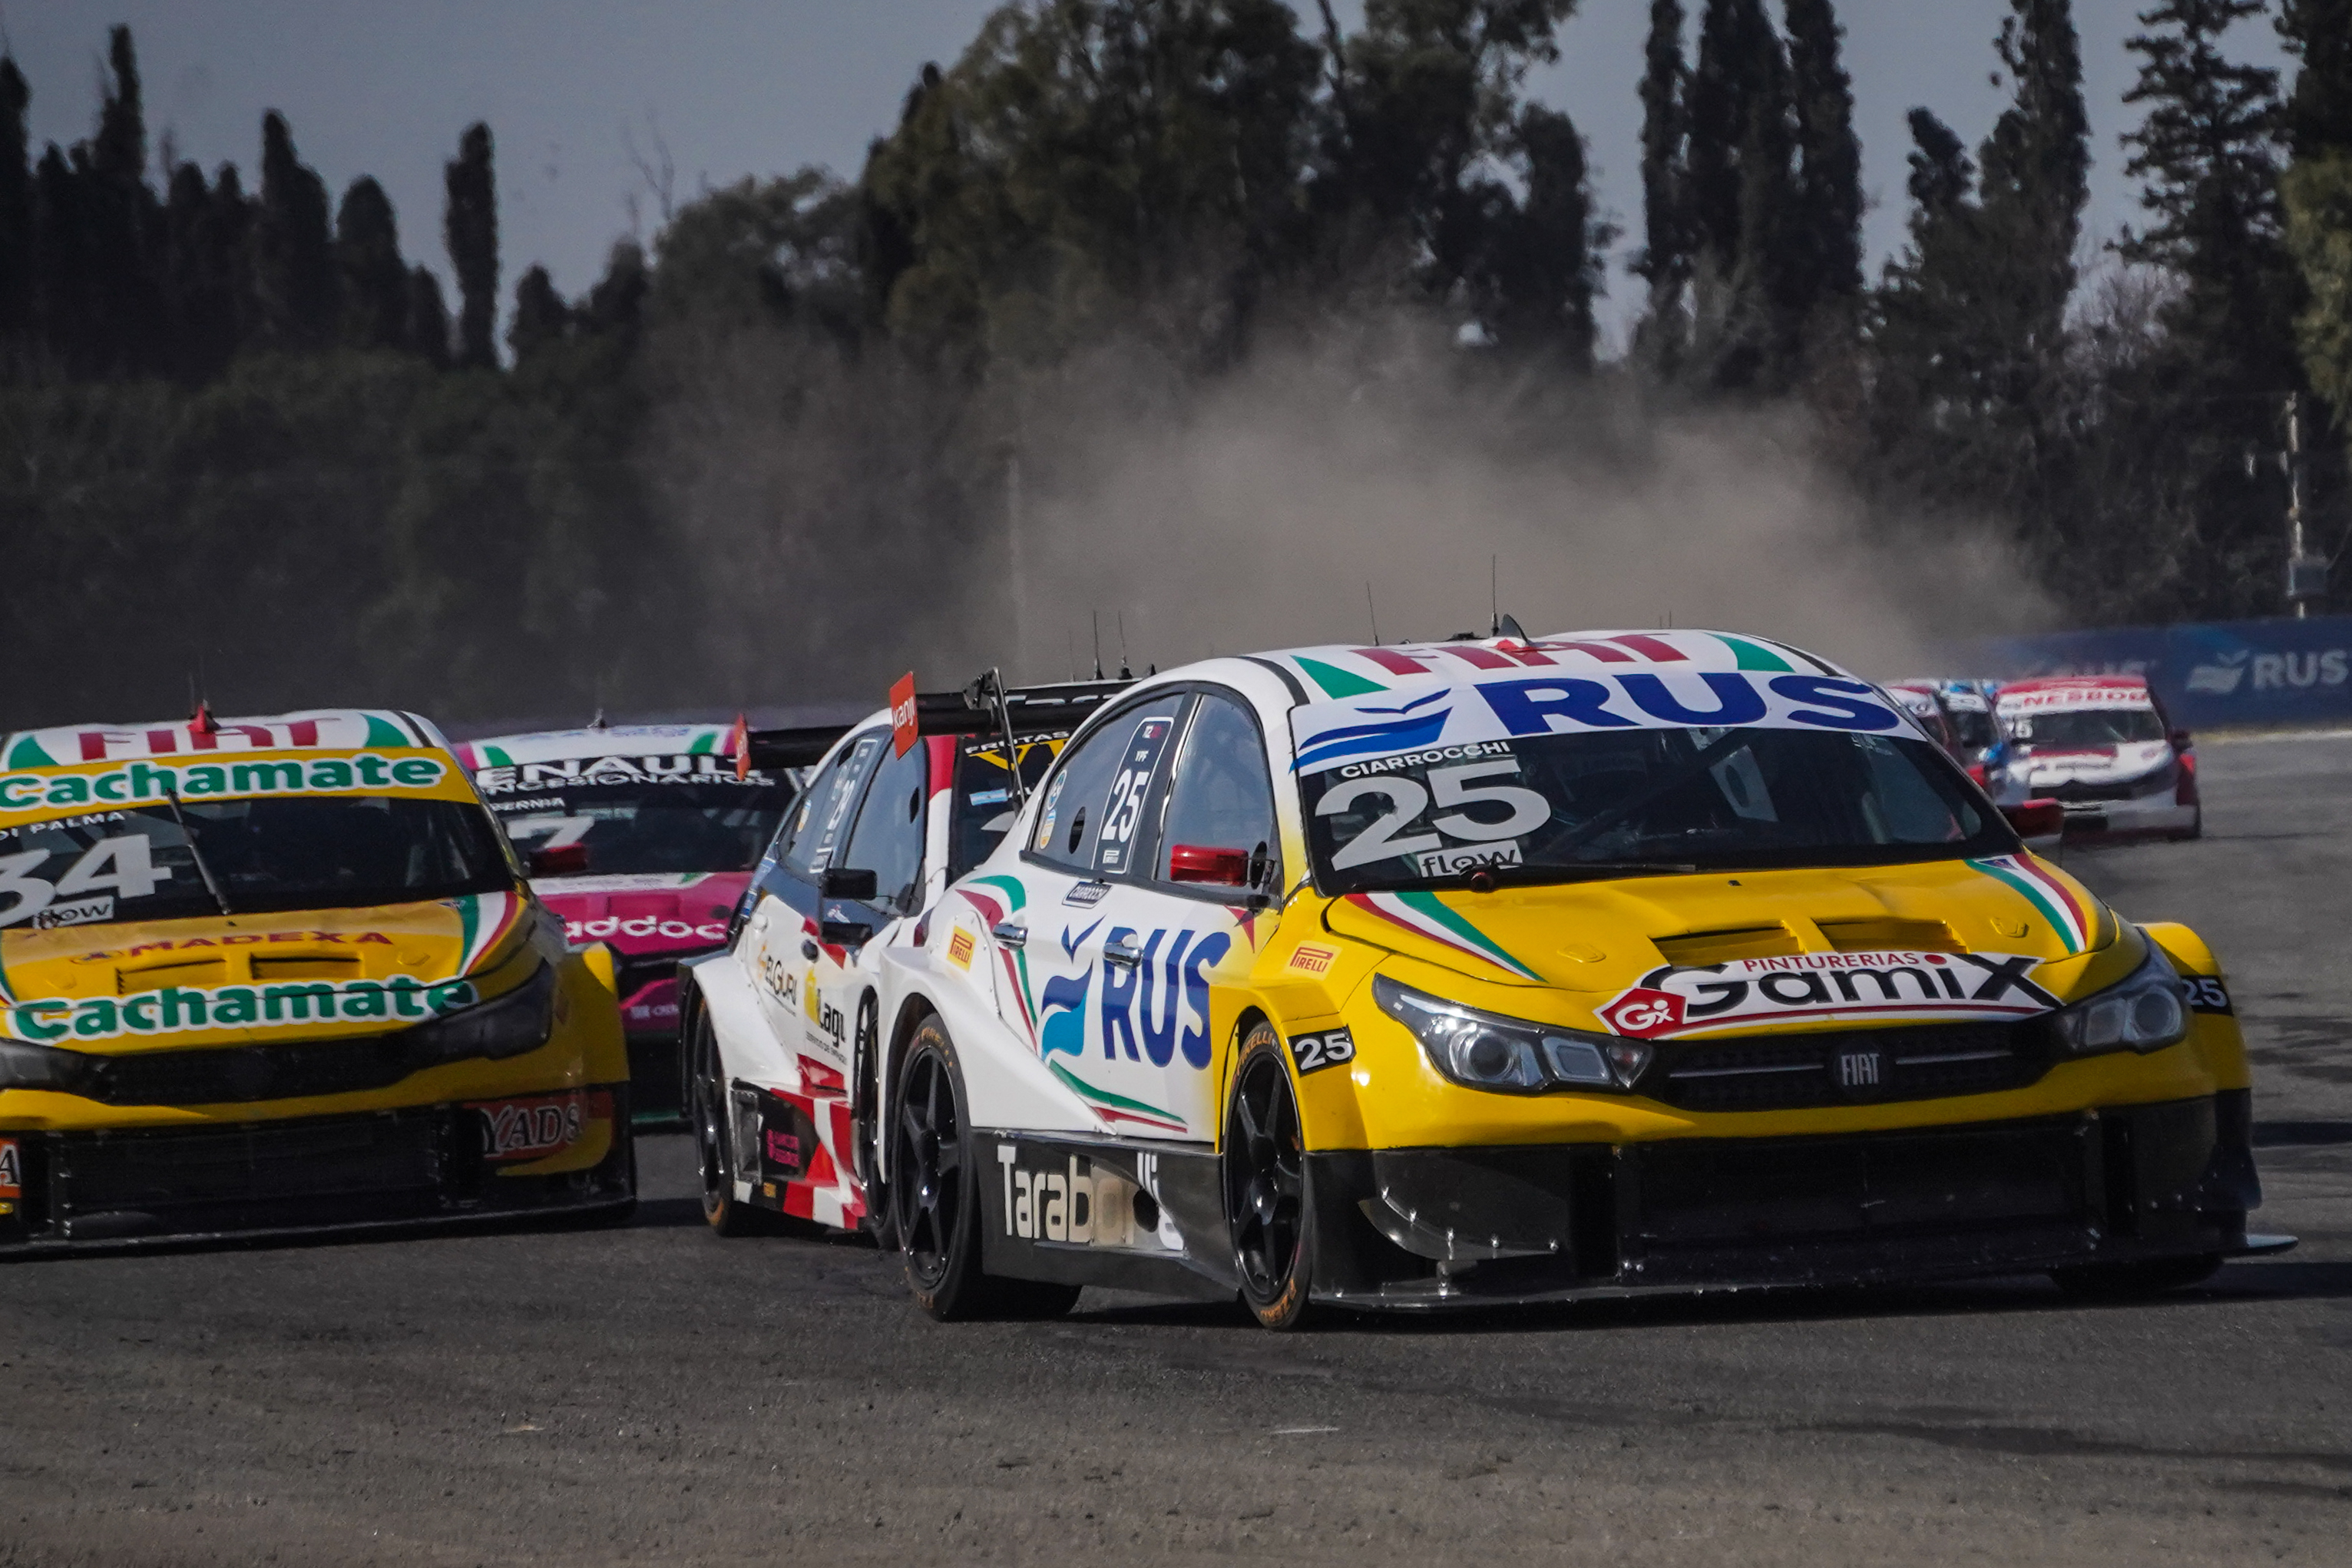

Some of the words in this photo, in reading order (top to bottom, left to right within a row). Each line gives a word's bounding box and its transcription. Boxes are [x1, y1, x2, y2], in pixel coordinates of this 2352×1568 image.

[1348, 633, 1690, 676] FIAT
[2251, 649, 2350, 690] RUS
[895, 696, 918, 731] kanji
[1474, 672, 1900, 736] RUS
[78, 717, 341, 761] FIAT
[476, 756, 762, 787] ENAUL
[1341, 740, 1511, 779] CIARROCCHI
[0, 755, 441, 808] Cachamate
[29, 812, 126, 834] PALMA
[1101, 769, 1150, 843] 25
[1315, 759, 1552, 872] 25
[0, 833, 173, 927] 34
[1422, 849, 1516, 877] flow
[131, 931, 394, 958] MADEXA
[950, 933, 973, 964] PIRELLI
[1290, 946, 1334, 973] PIRELLI
[1743, 952, 1920, 973] PINTURERIAS
[14, 977, 476, 1040] Cachamate
[1101, 926, 1231, 1070] RUS
[2182, 978, 2228, 1007] 25
[1295, 1033, 1353, 1071] 25
[1843, 1053, 1880, 1086] FIAT
